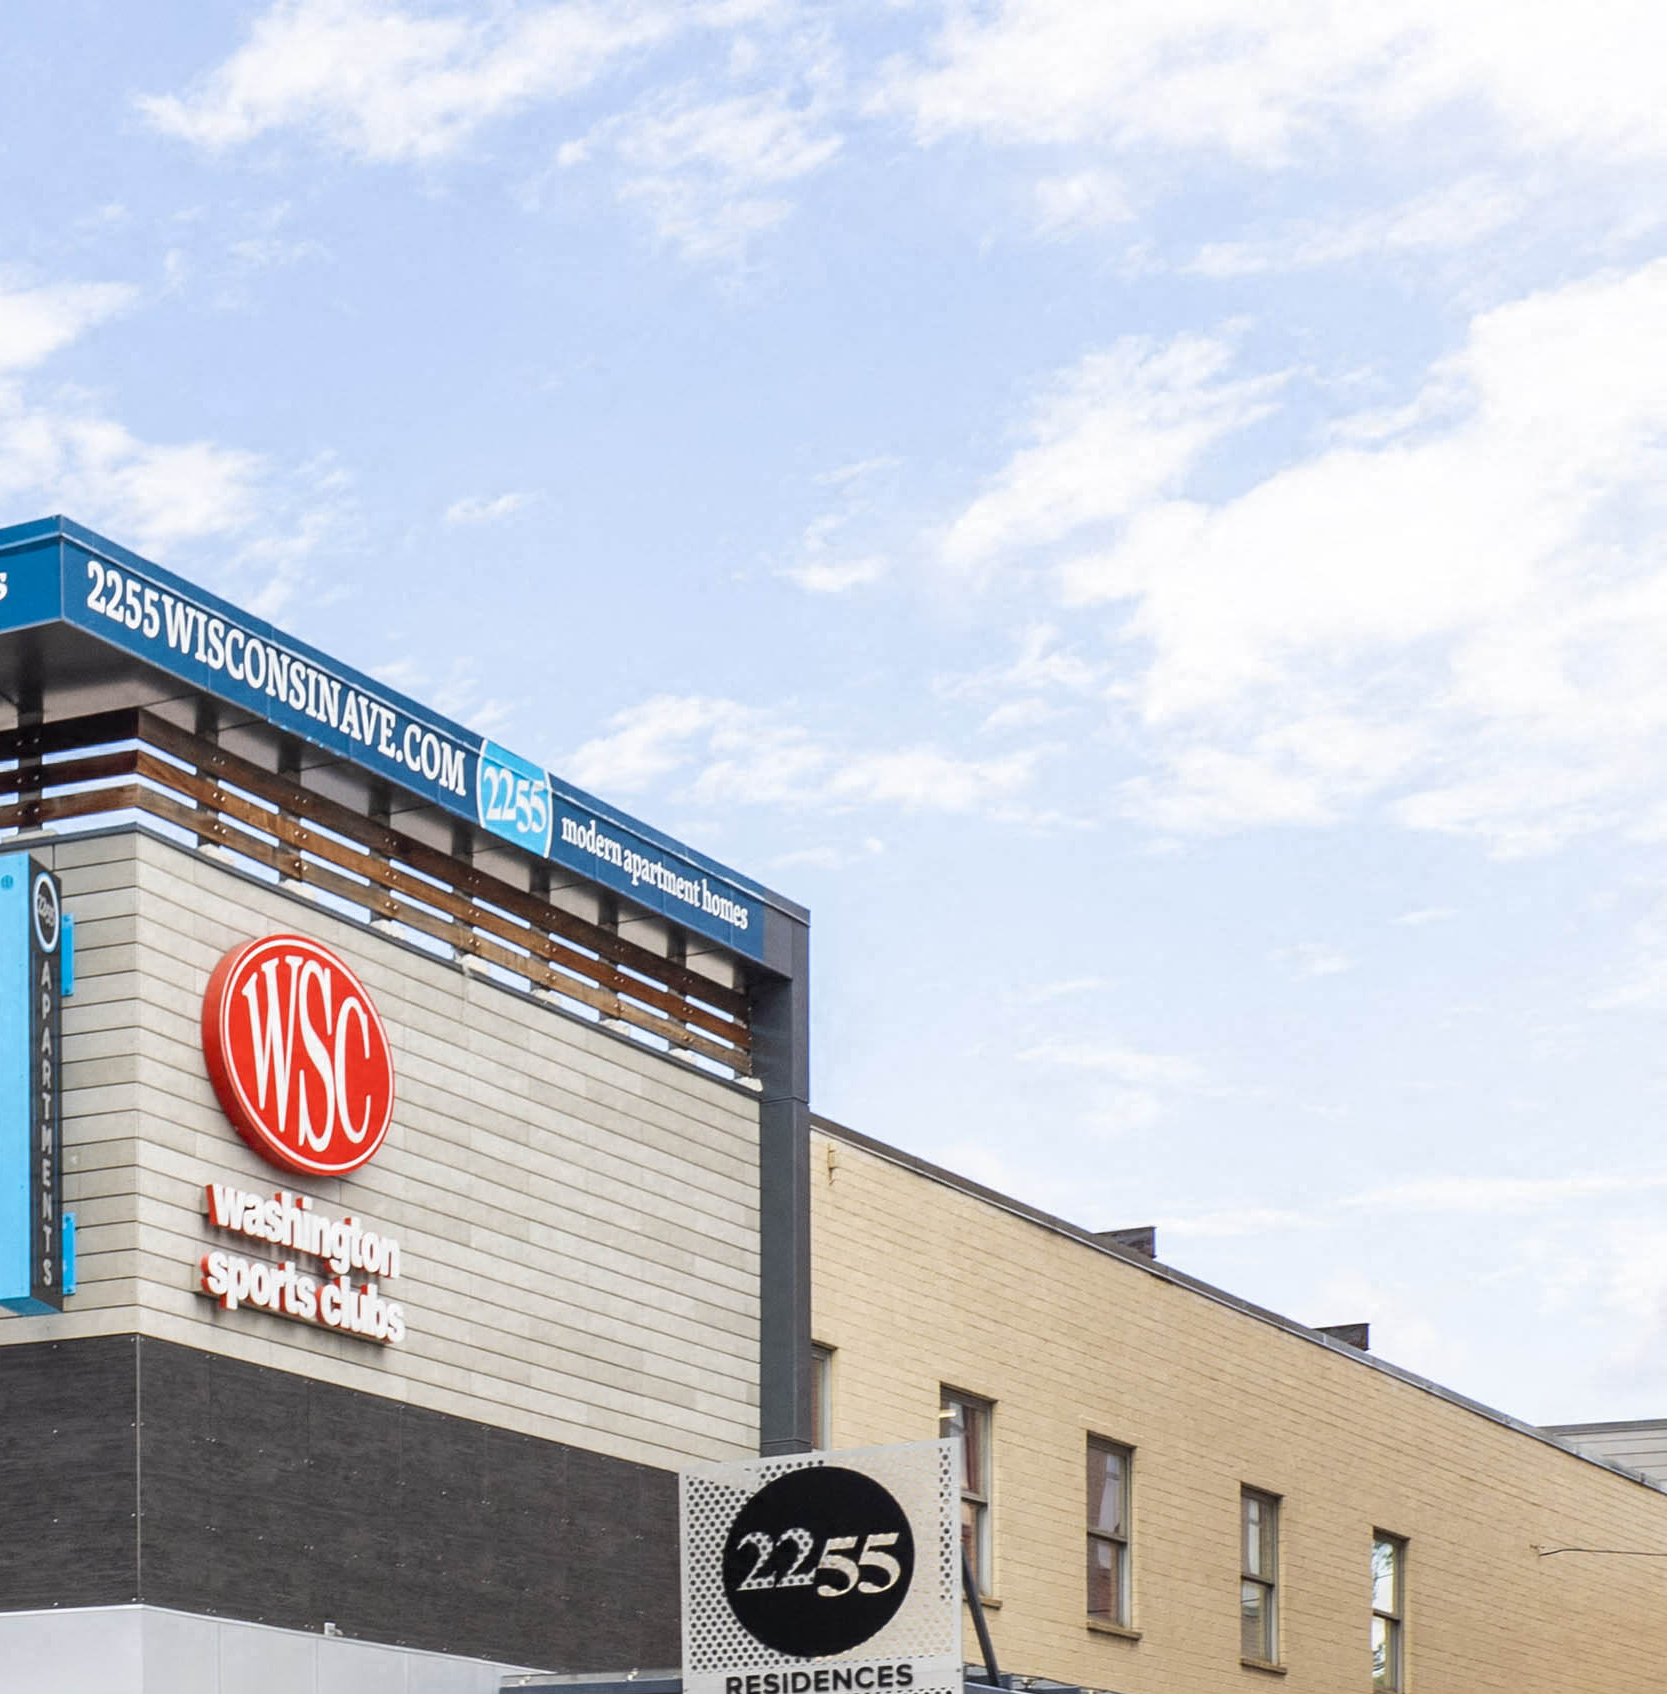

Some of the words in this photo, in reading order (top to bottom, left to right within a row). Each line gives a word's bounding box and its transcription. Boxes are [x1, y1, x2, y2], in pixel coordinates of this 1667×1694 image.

[482, 766, 547, 833] 2255
[561, 816, 624, 869] modern
[623, 849, 701, 908] apartment
[701, 878, 749, 931] homes
[242, 954, 371, 1153] WSC
[41, 960, 53, 1286] APARTMENTS
[209, 1182, 400, 1279] washington
[203, 1250, 318, 1322] sports
[319, 1274, 407, 1344] clubs
[736, 1527, 902, 1597] 2255
